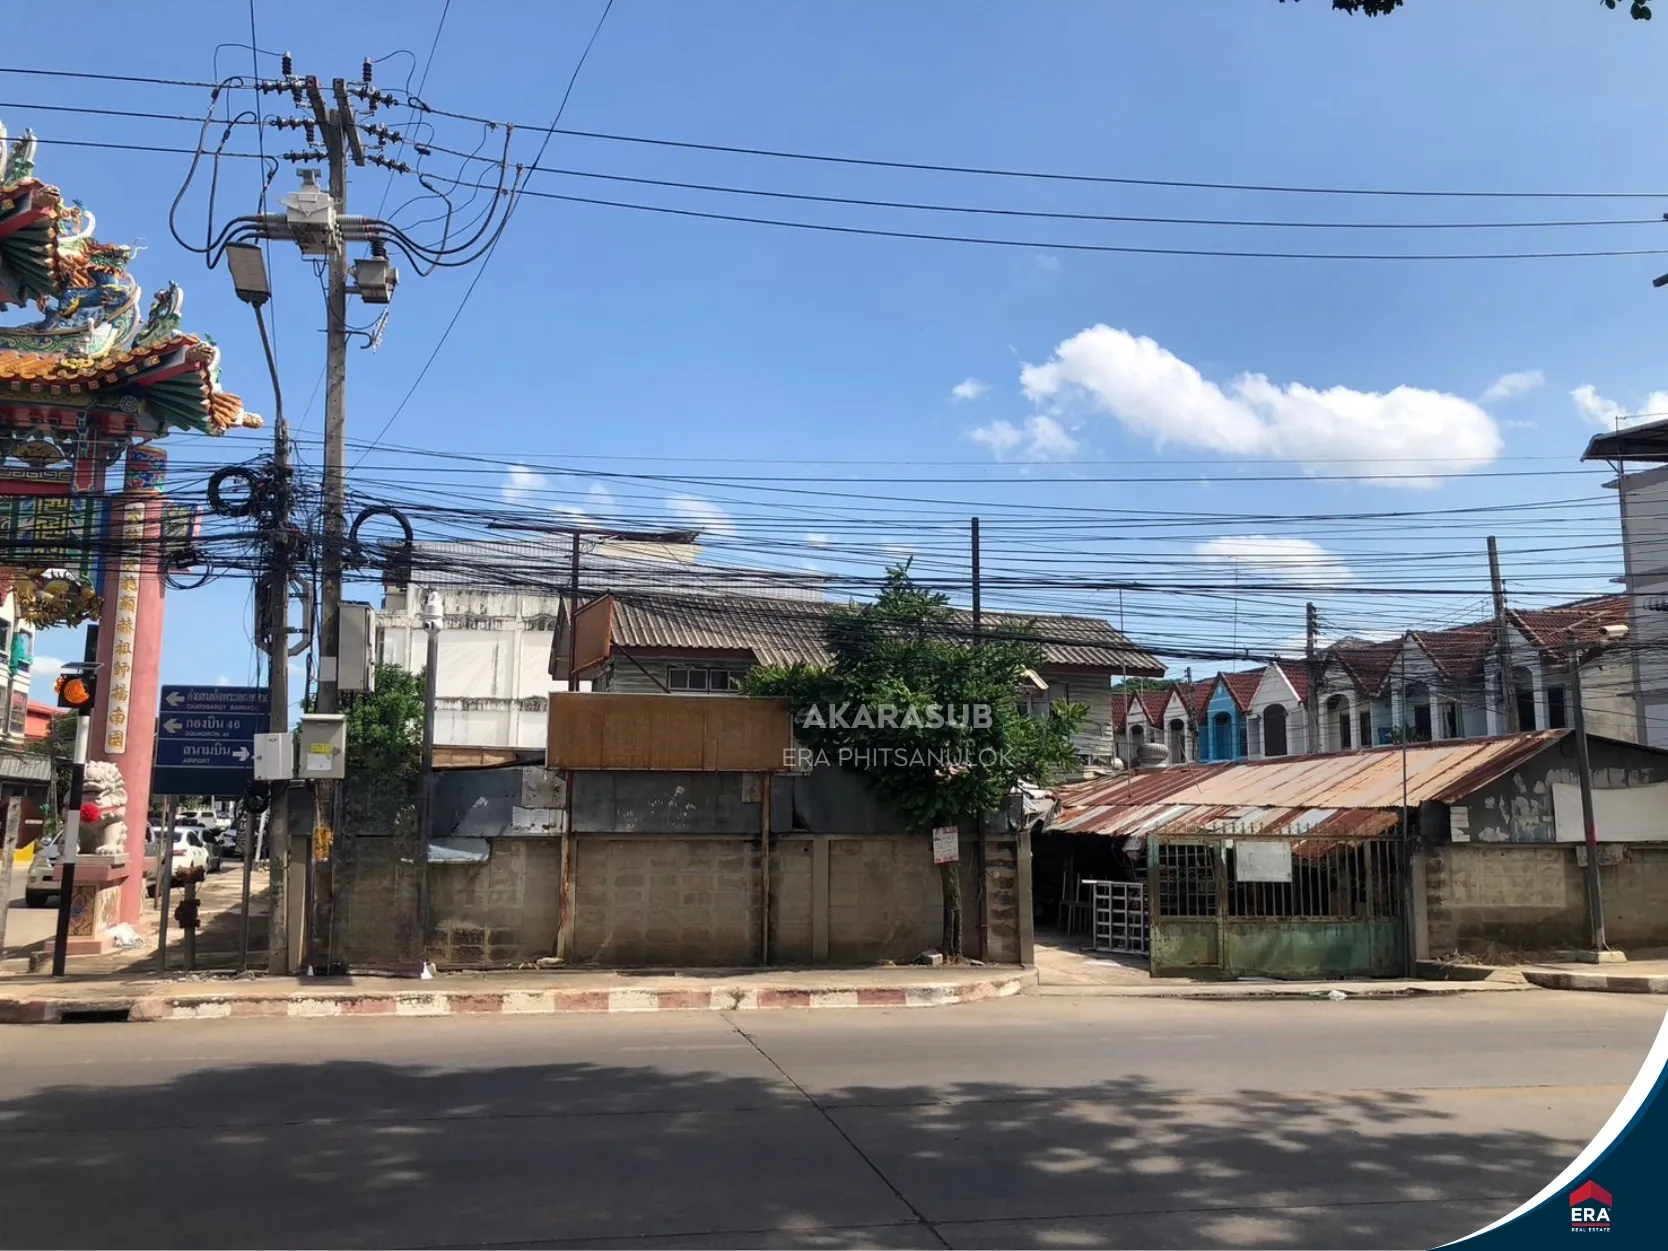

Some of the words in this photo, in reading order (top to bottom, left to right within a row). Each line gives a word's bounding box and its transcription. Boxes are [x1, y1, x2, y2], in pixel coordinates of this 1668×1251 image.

[186, 715, 224, 729] กองบิน
[226, 720, 240, 729] 46
[183, 742, 231, 755] สนามบิน
